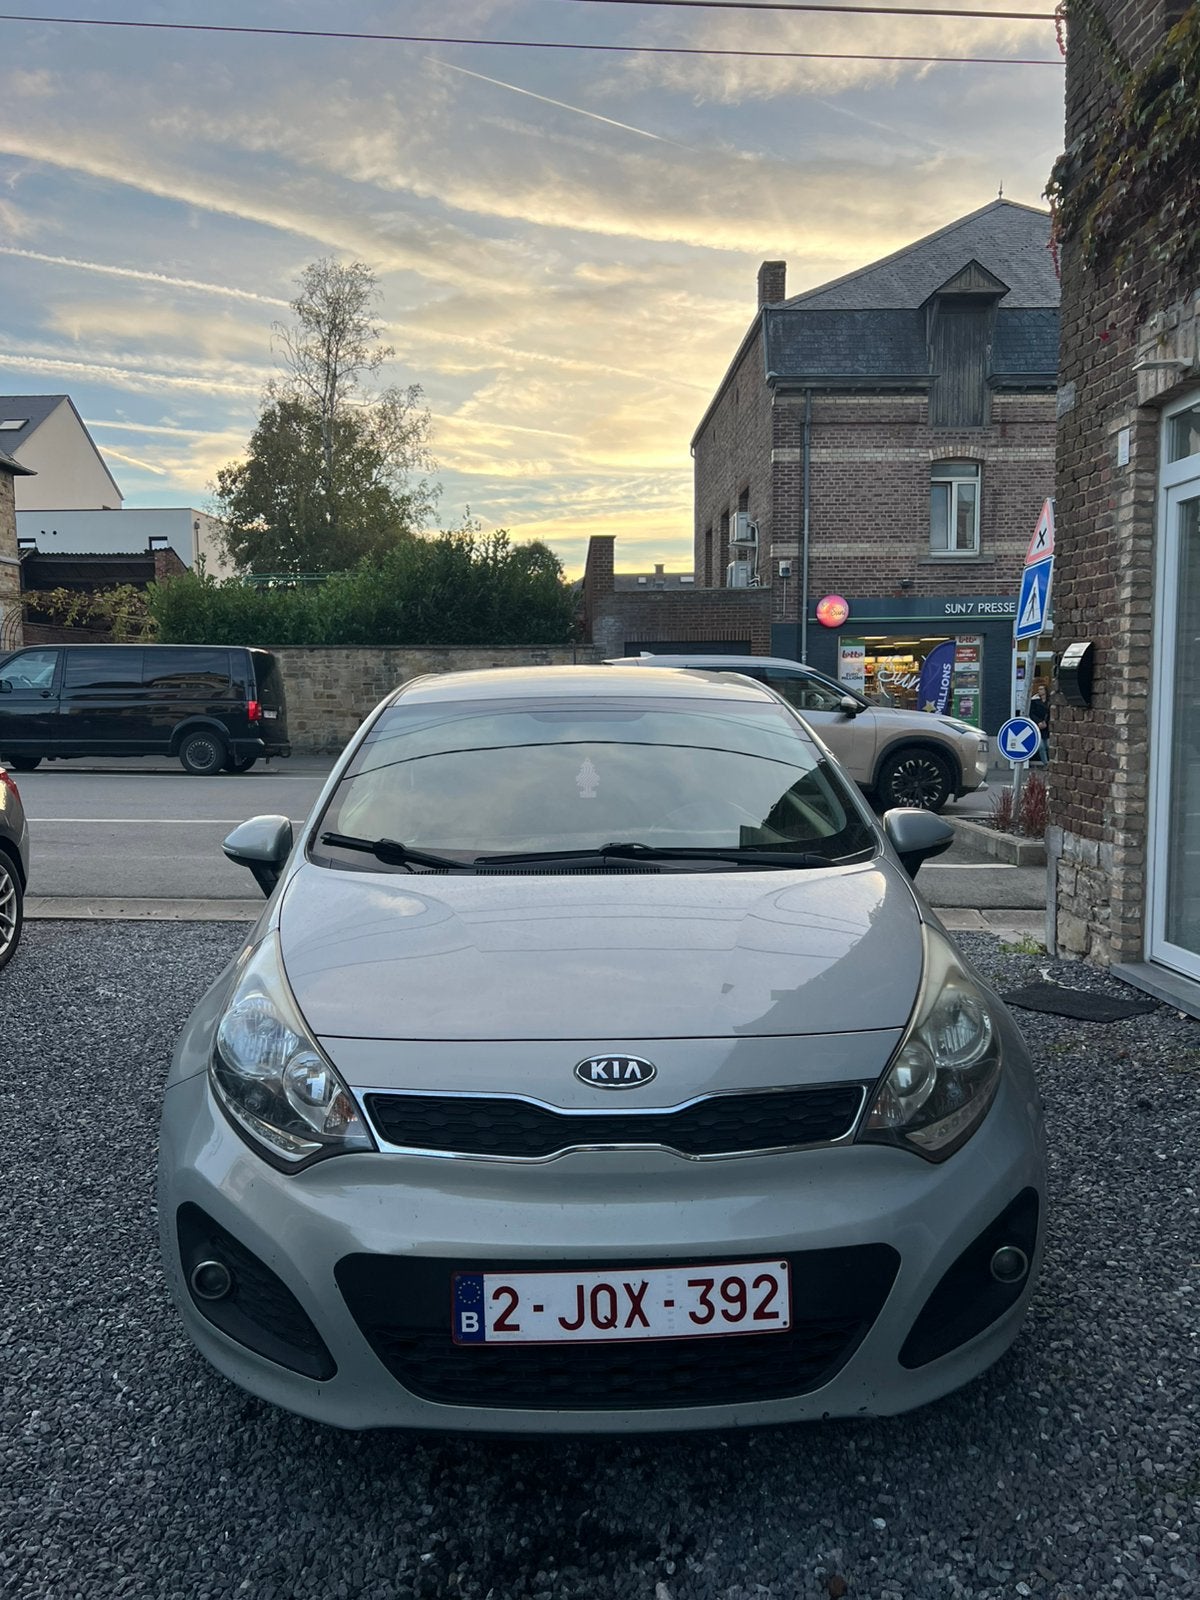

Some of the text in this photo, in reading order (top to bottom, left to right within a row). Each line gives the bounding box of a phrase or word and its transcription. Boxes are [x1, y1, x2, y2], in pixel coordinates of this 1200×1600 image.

[944, 602, 1016, 614] SUN 7 PRESSE
[841, 650, 864, 659] lotto
[590, 1061, 642, 1079] KIA
[461, 1312, 479, 1333] B
